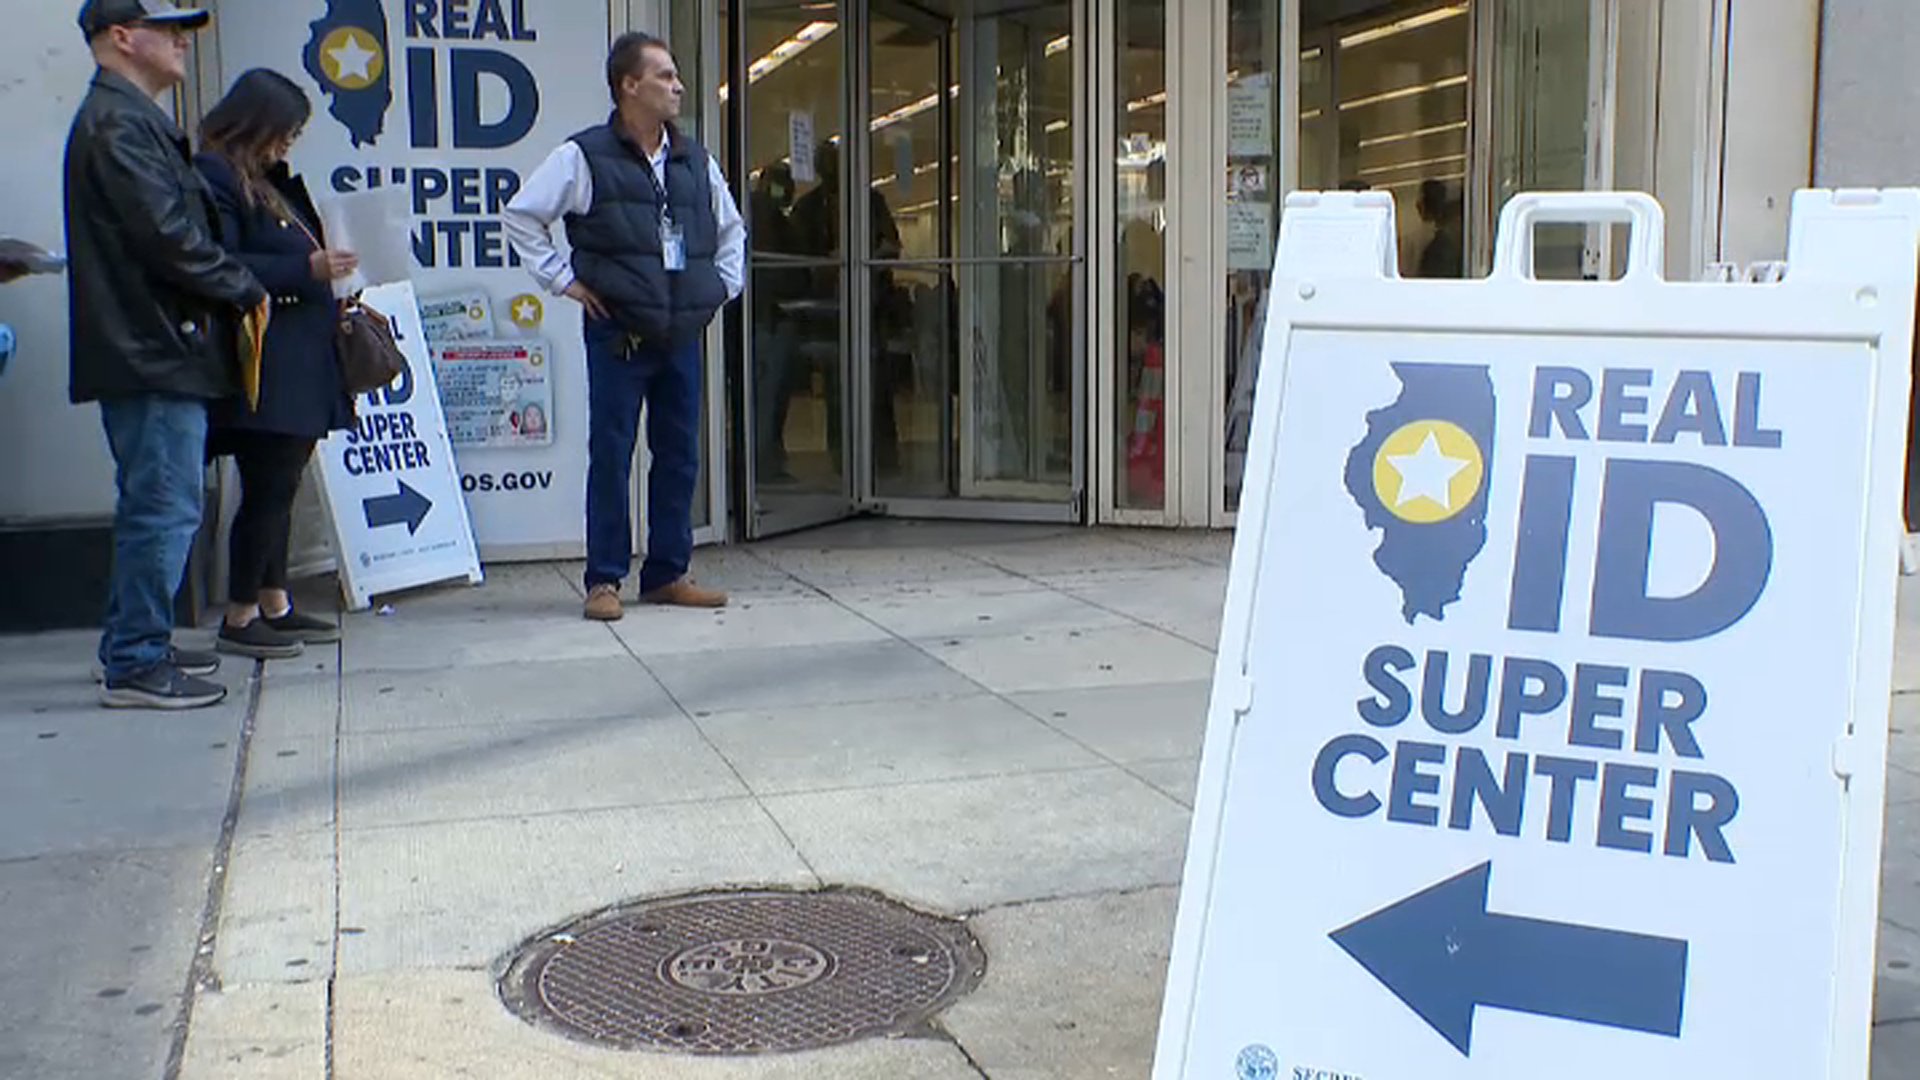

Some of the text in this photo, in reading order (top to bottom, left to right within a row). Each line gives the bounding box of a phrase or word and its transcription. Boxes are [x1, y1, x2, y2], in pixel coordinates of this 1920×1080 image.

[403, 0, 537, 42] REAL
[405, 46, 540, 150] ID
[1529, 366, 1782, 448] REAL
[343, 440, 431, 476] CENTER
[460, 471, 553, 493] OS.GOV
[1507, 454, 1774, 643] ID
[1357, 645, 1708, 759] SUPER
[1311, 732, 1739, 864] CENTER
